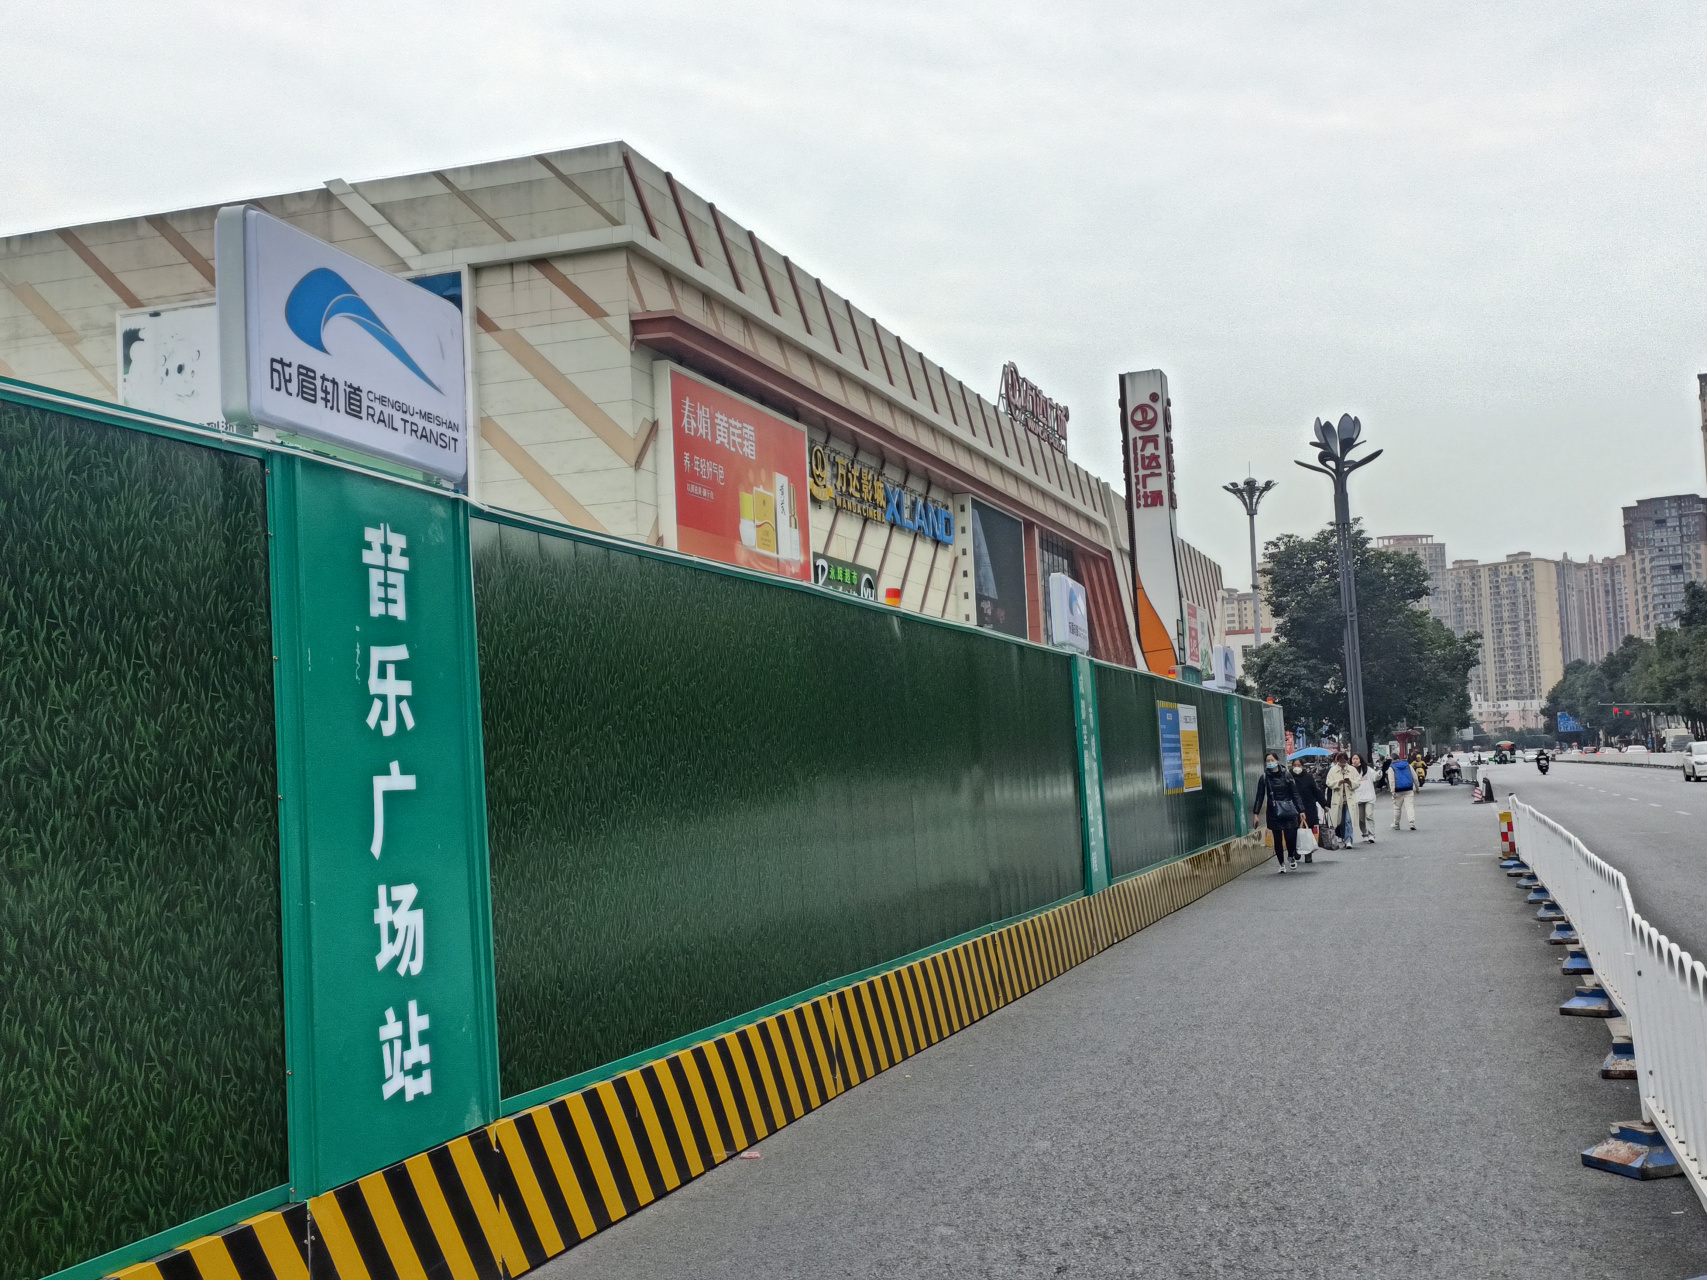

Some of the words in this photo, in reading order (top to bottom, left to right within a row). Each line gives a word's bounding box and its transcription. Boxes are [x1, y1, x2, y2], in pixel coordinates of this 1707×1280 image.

[269, 356, 363, 421] 成眉轨道
[366, 390, 460, 433] CHENGDU-MEISHAN
[366, 404, 399, 432] RAIL
[400, 417, 459, 453] TRANSIT
[680, 396, 712, 442] 春娟
[714, 411, 757, 460] 黄芪霜
[834, 456, 887, 509] 万达影城
[1138, 433, 1164, 508] 万达广场
[835, 495, 861, 516] WANDA
[862, 504, 885, 524] CINEMA
[884, 481, 954, 545] XLAND
[828, 563, 858, 586] 永辉超市
[361, 521, 433, 1103] 音乐广场站
